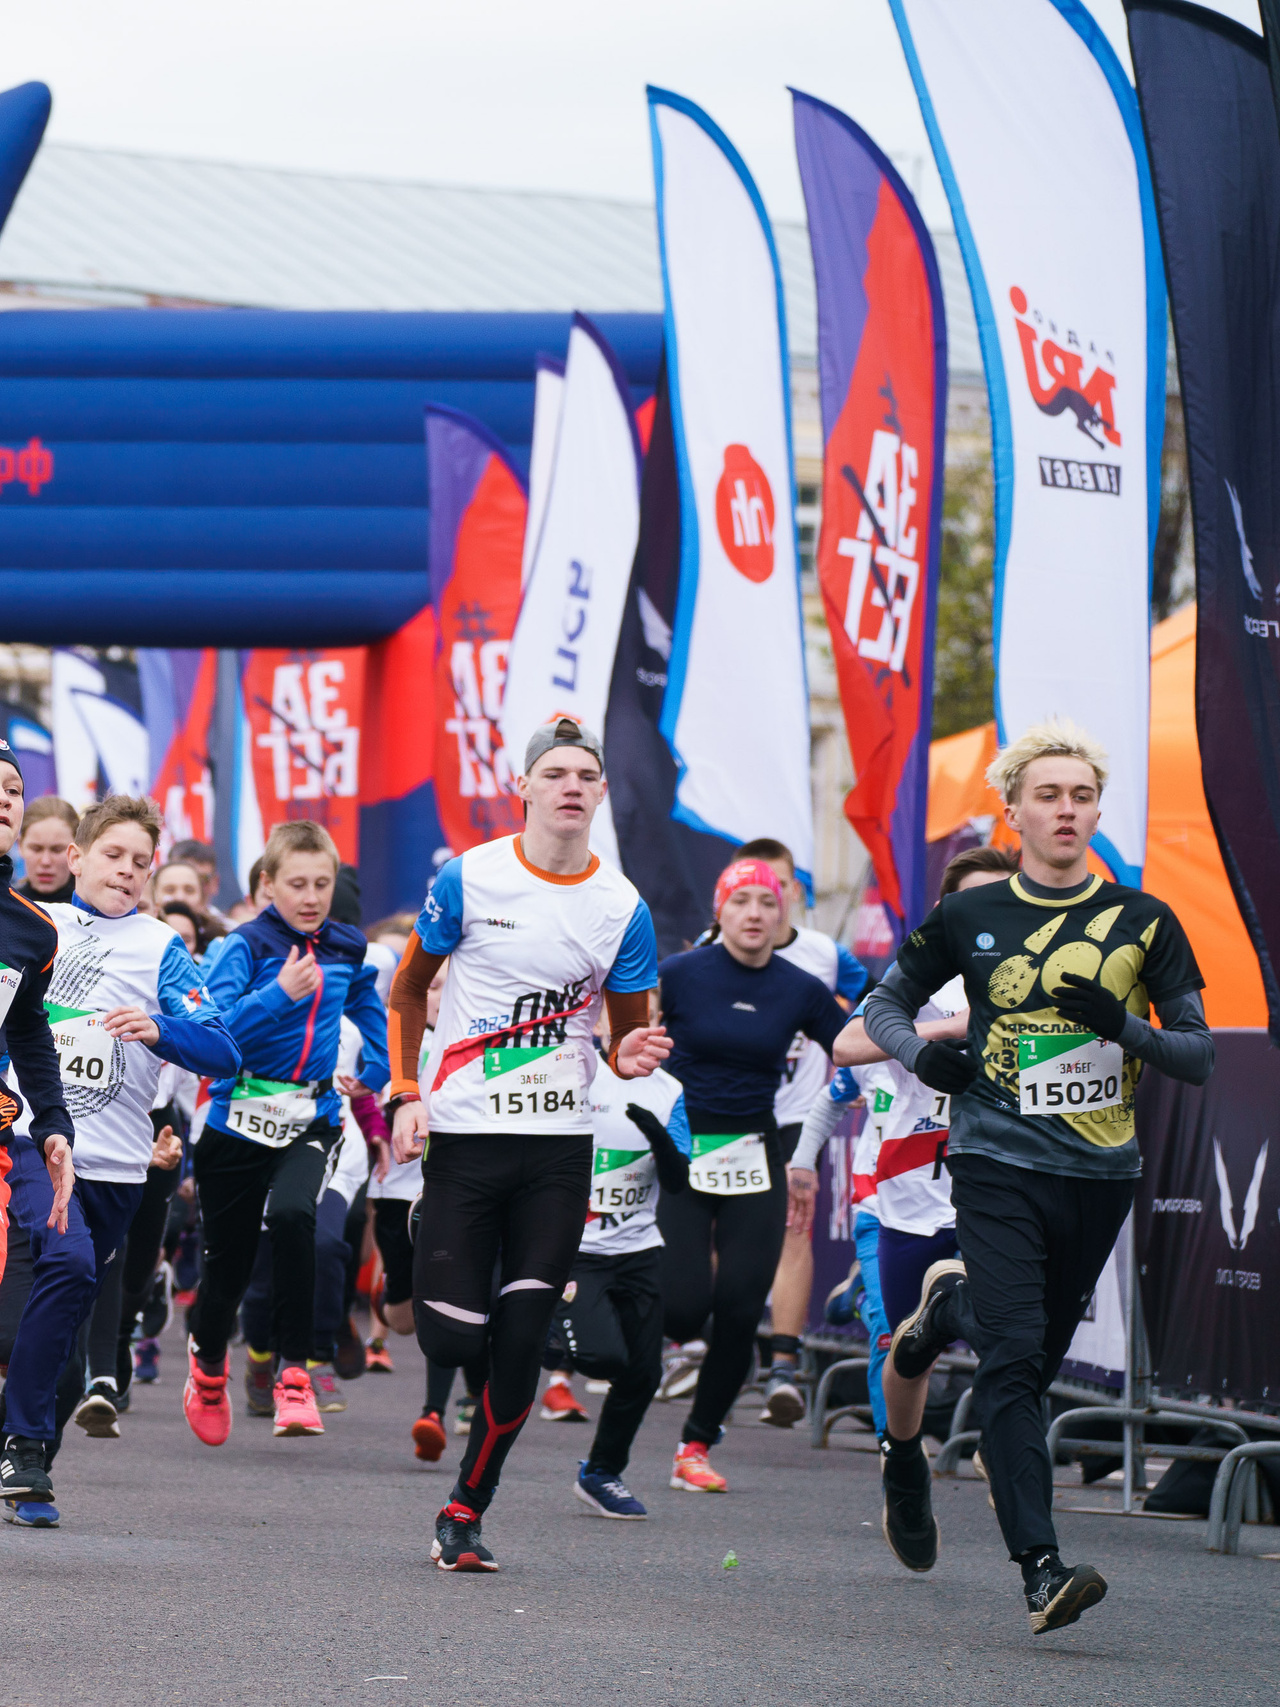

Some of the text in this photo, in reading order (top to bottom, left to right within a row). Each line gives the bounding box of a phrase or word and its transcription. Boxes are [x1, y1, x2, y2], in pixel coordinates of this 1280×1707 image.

[489, 1089, 576, 1114] 15184
[1025, 1075, 1118, 1106] 15020
[693, 1169, 763, 1189] 15156
